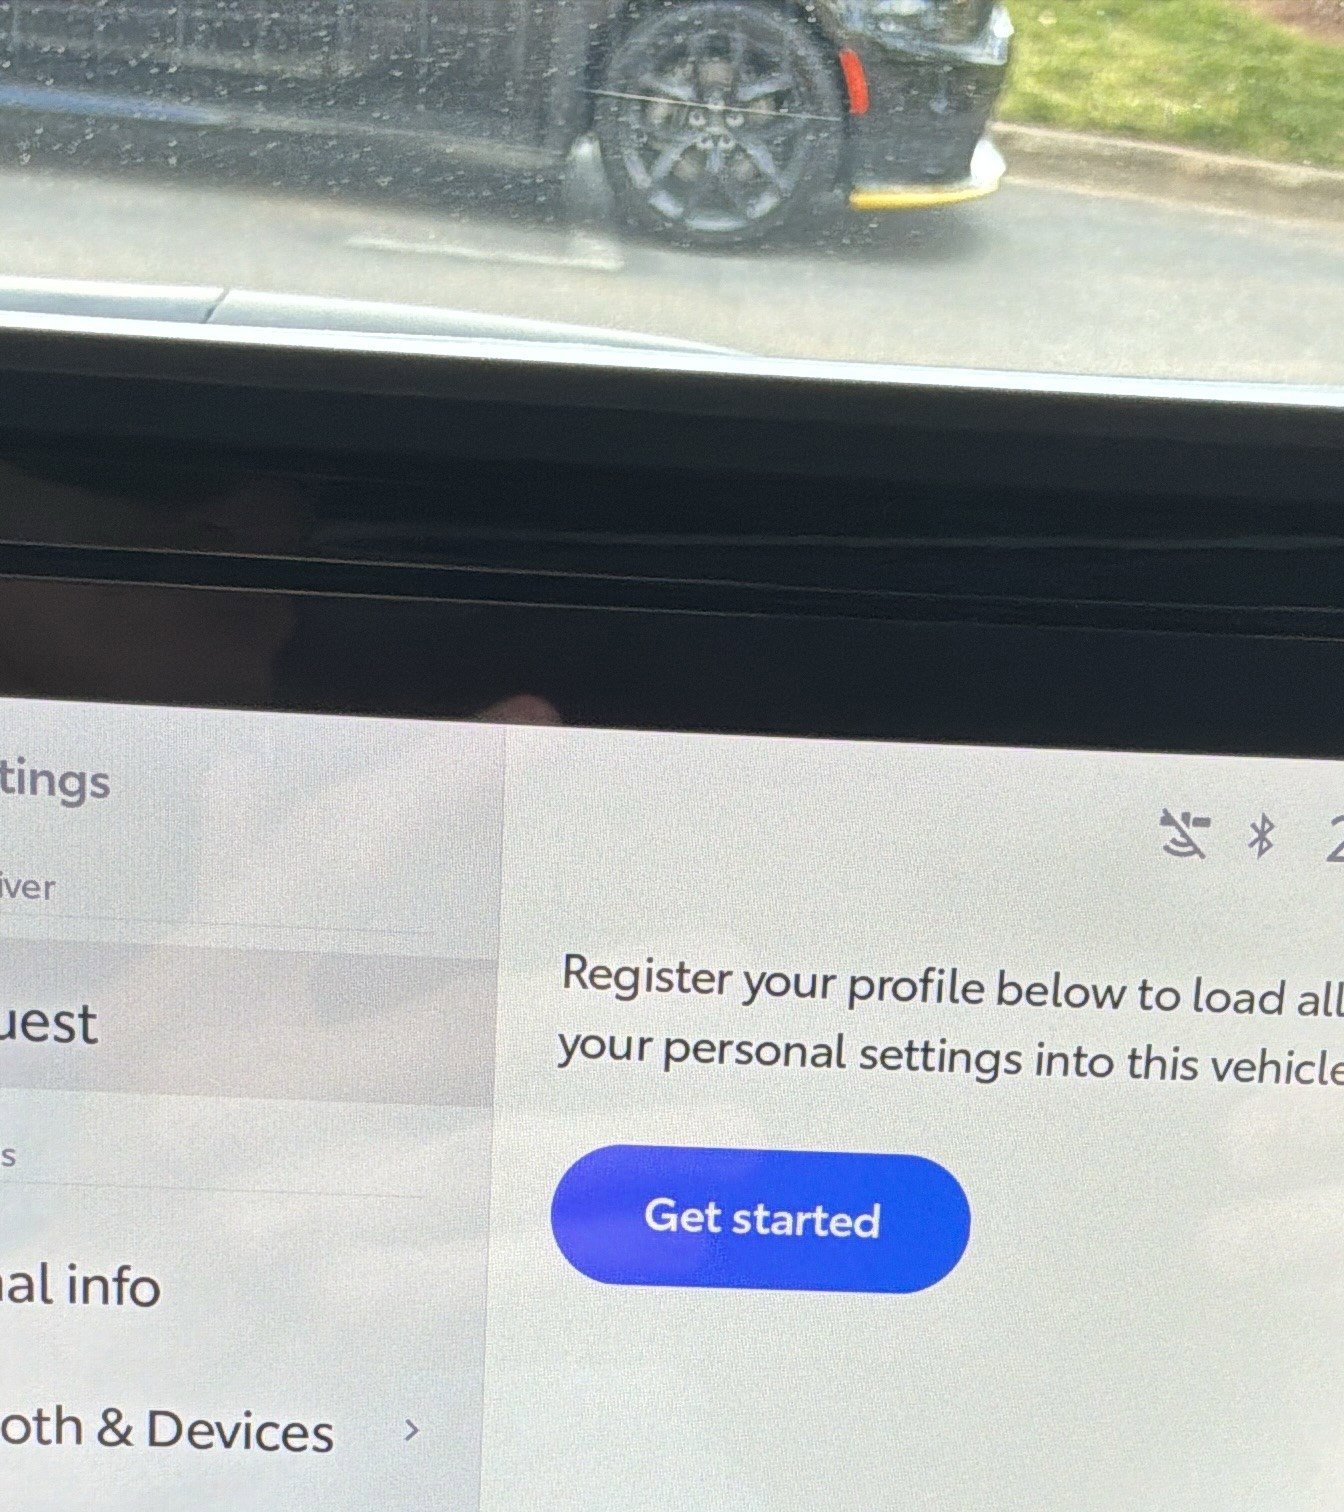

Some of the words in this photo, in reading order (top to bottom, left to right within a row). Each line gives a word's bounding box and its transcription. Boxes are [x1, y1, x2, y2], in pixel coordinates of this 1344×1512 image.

[564, 954, 733, 1001] Register
[743, 972, 836, 1006] your
[849, 967, 984, 1010] profile
[998, 970, 1126, 1009] below
[1139, 979, 1180, 1011] to
[1194, 977, 1285, 1014] load
[1298, 981, 1344, 1017] all
[558, 1034, 653, 1068] your
[664, 1033, 845, 1072] personal
[860, 1038, 1021, 1084] settings
[1037, 1042, 1114, 1077] into
[1128, 1044, 1198, 1080] this
[646, 1198, 720, 1232] Get
[733, 1204, 880, 1238] started
[69, 1264, 160, 1307] info
[98, 1408, 132, 1447] &
[149, 1410, 333, 1452] Devices
